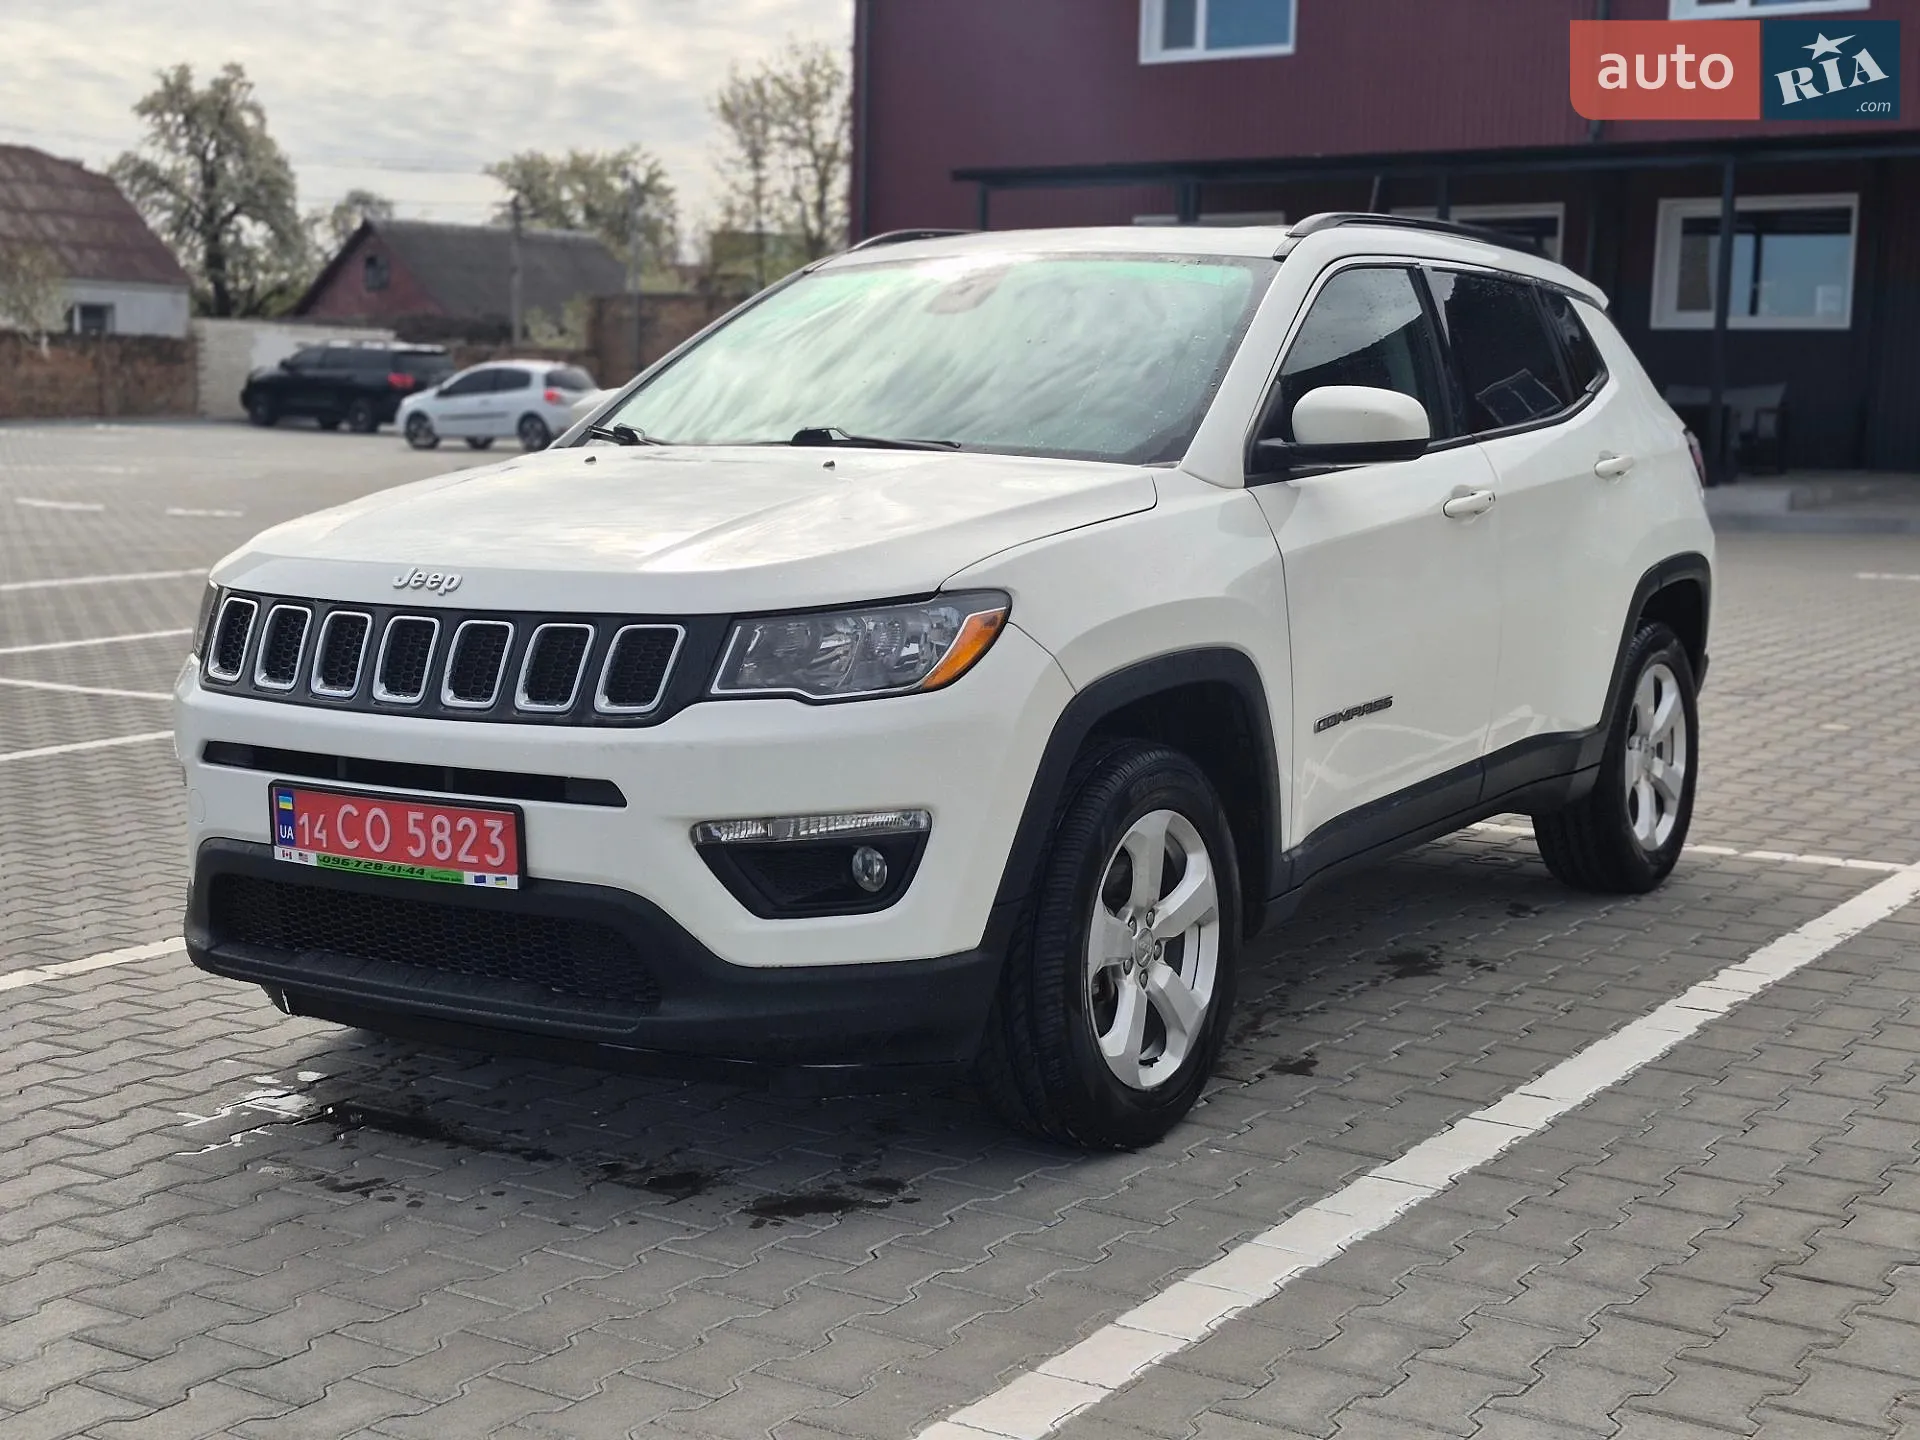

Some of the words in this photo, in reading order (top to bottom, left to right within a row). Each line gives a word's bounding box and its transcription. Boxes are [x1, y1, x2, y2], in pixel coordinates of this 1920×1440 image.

[392, 567, 463, 596] Jeep
[1313, 695, 1393, 734] COMPASS
[279, 824, 294, 840] UA
[298, 812, 328, 849] 14
[336, 803, 391, 853] CO
[407, 811, 506, 867] 5823
